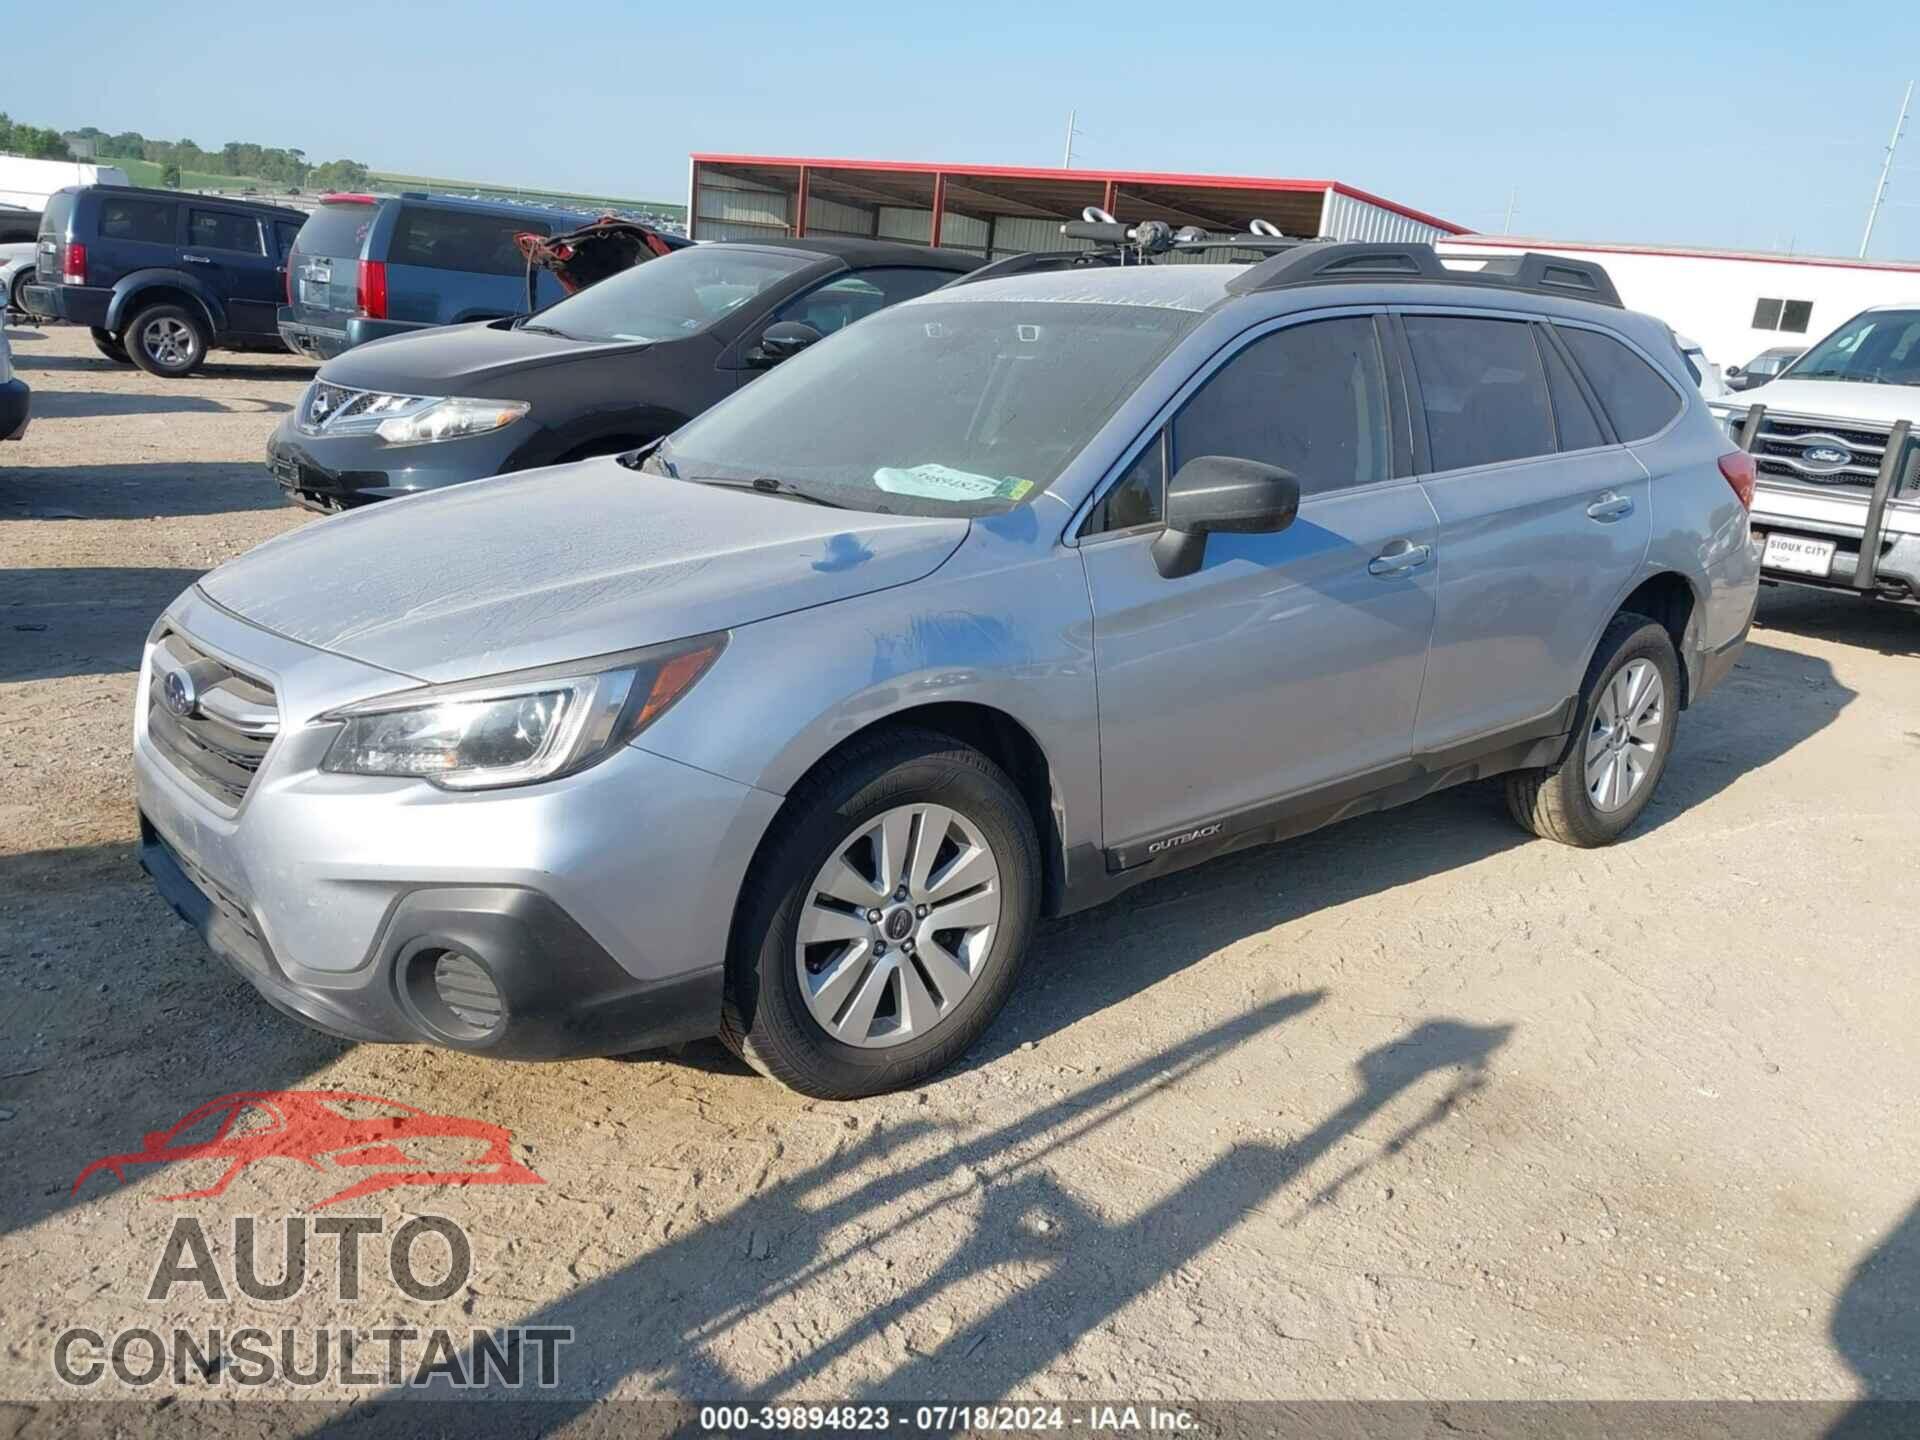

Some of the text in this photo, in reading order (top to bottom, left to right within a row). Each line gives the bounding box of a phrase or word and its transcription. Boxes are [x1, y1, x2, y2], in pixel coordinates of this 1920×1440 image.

[1769, 540, 1829, 557] SIOUX CITY
[1148, 823, 1223, 853] OUTBACK
